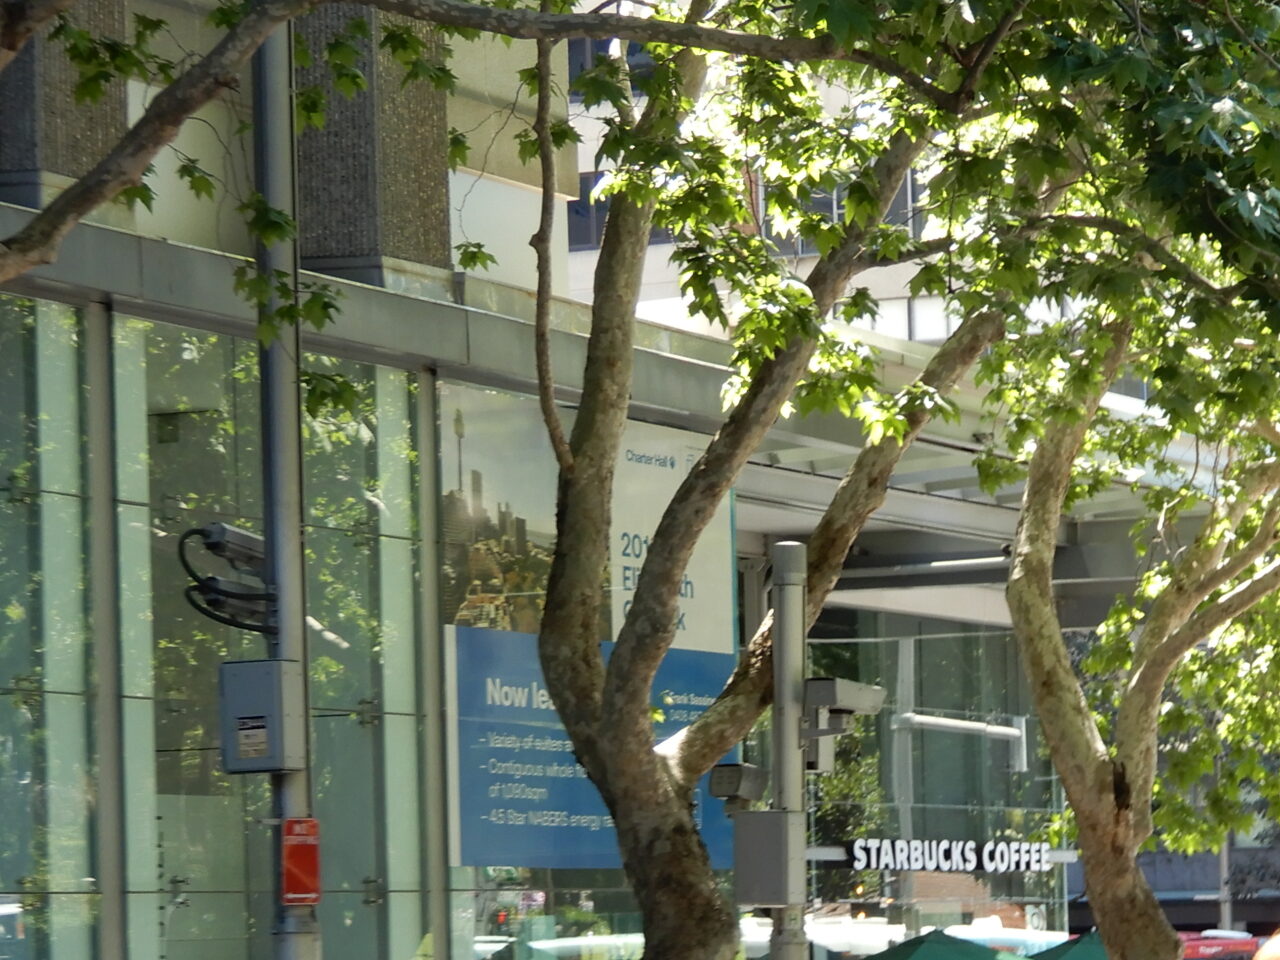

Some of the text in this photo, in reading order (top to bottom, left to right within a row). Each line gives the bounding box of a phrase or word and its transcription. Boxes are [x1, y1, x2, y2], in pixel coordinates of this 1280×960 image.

[625, 449, 653, 466] Charter
[486, 677, 529, 708] Now
[853, 838, 1051, 873] STARBUCKS COFFEE
